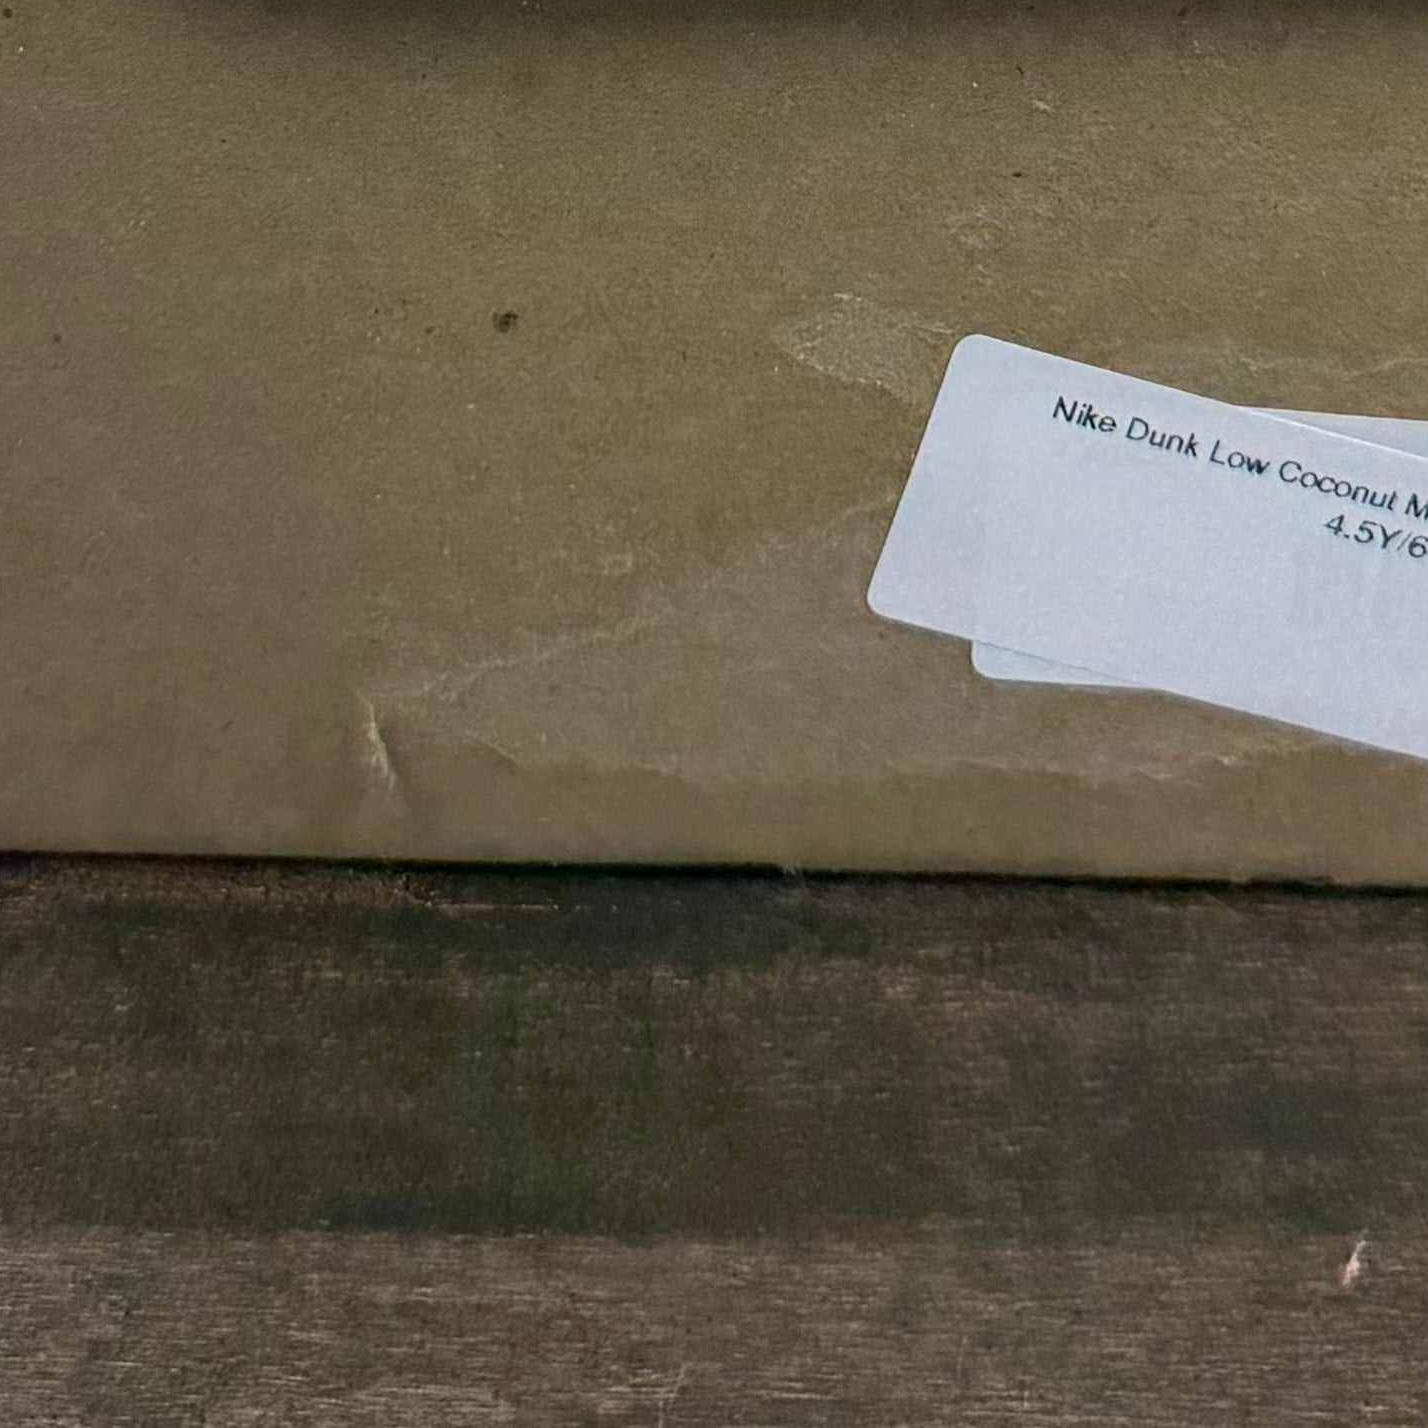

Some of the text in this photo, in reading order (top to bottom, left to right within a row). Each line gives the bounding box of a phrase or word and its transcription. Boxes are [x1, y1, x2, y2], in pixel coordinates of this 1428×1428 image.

[1052, 396, 1117, 433] Nike
[1125, 417, 1200, 457] Dunk
[1209, 440, 1270, 476] Low
[1279, 461, 1398, 511] Coconut
